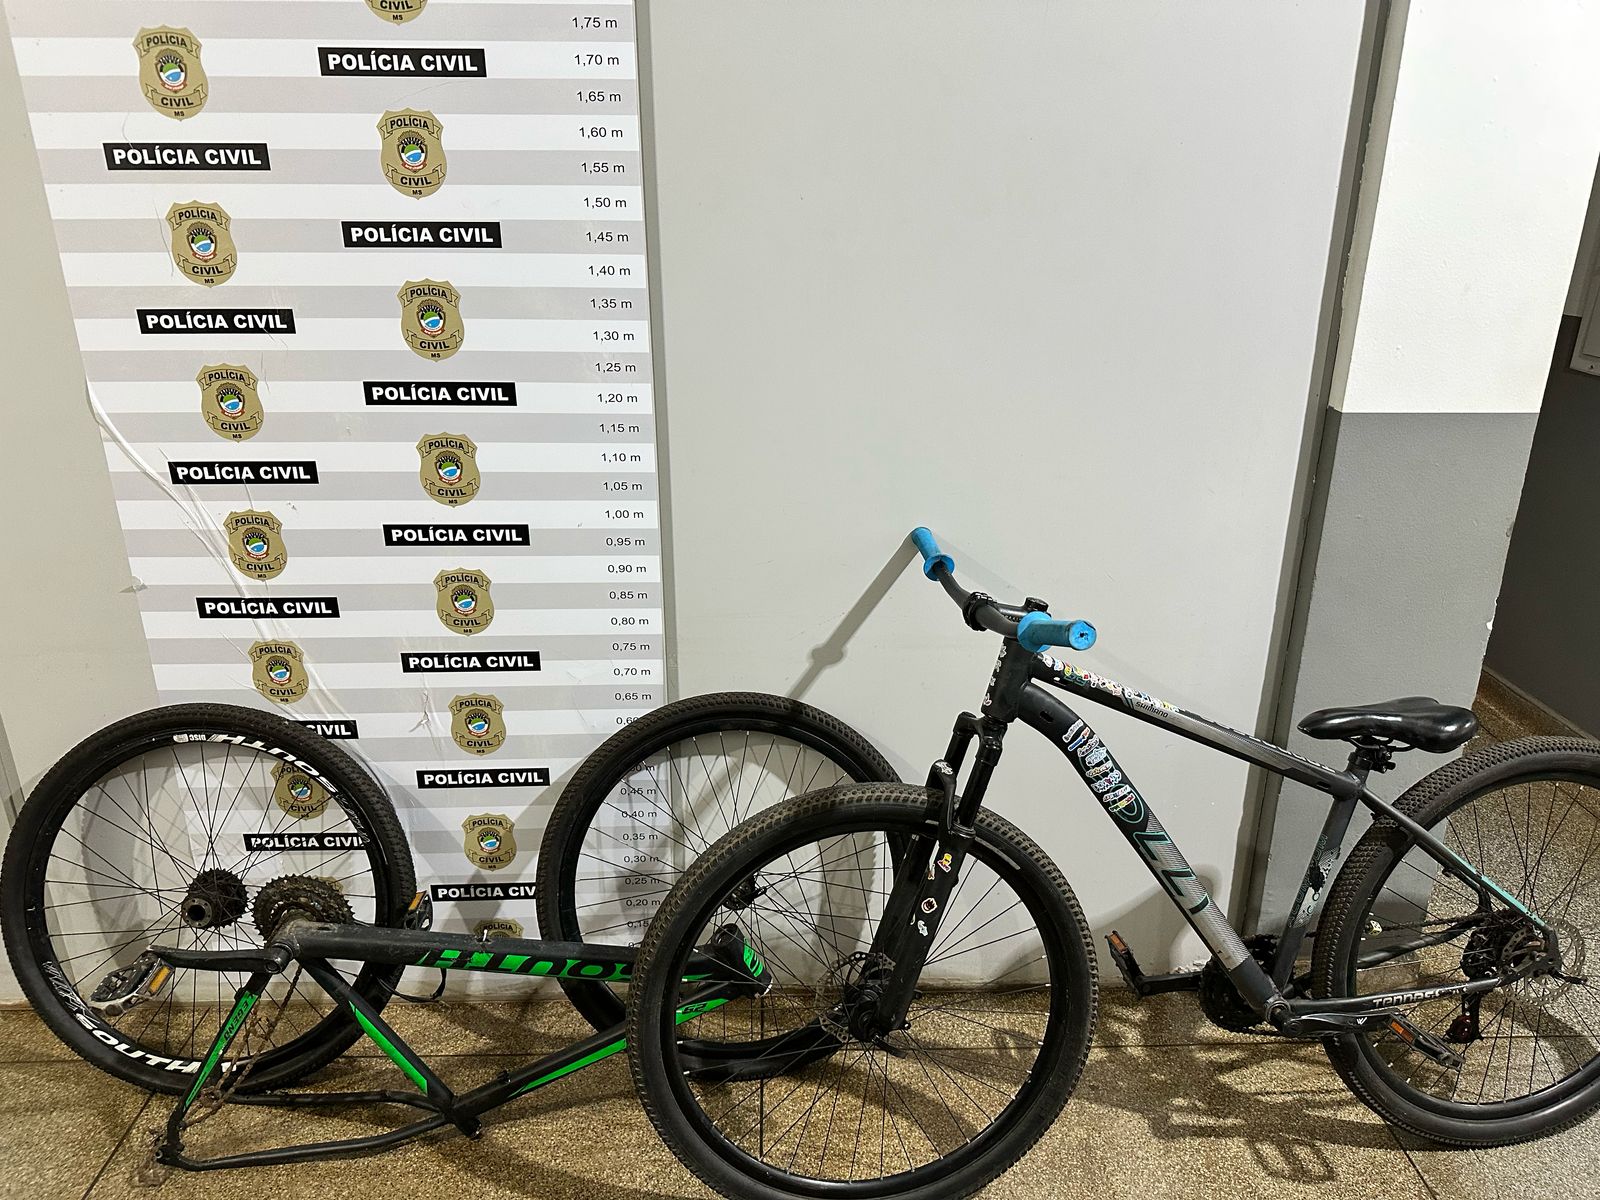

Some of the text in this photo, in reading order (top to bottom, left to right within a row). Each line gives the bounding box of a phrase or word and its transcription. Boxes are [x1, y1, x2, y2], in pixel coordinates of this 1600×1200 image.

[380, 0, 413, 10] CIVIL
[572, 17, 617, 29] 1,75 m
[146, 33, 187, 48] POLÍCIA
[328, 50, 477, 72] POLÍCIA CIVIL
[575, 54, 619, 66] 1,70 m
[161, 97, 194, 107] CIVIL
[577, 91, 621, 103] 1,65 m
[390, 116, 430, 130] POLÍCIA
[579, 127, 623, 139] 1,60 m
[113, 145, 262, 165] POLÍCIA CIVIL
[582, 162, 625, 174] 1,55 m
[400, 176, 432, 187] CIVIL
[584, 197, 610, 209] 1,50
[178, 208, 218, 221] POLÍCIA
[351, 224, 494, 243] POLÍCIA CIVIL
[586, 231, 629, 243] 1,45 m
[192, 265, 223, 275] CIVIL
[589, 265, 615, 277] 1,40
[410, 286, 447, 299] POLÍCIA
[591, 298, 617, 310] 1,35
[146, 311, 288, 329] POLÍCIA CIVIL
[593, 331, 619, 342] 1,30
[419, 340, 450, 350] CIVIL
[596, 363, 621, 374] 1,25
[208, 370, 245, 382] POLÍCIA
[372, 383, 509, 401] POLÍCIA CIVIL
[598, 394, 623, 404] 1,20
[220, 422, 250, 431] CIVIL
[600, 424, 625, 434] 1,15
[428, 438, 465, 450] POLÍCIA
[602, 453, 627, 463] 1,10
[177, 464, 311, 480] POLÍCIA CIVIL
[437, 488, 467, 496] CIVIL
[603, 482, 628, 492] 1,05
[234, 515, 270, 526] POLÍCIA
[605, 510, 630, 520] 1,00
[392, 526, 523, 542] POLÍCIA CIVIL
[606, 538, 631, 547] 0,95
[246, 563, 275, 571] CIVIL
[608, 564, 633, 574] 0,90
[444, 573, 480, 584] POLÍCIA
[610, 591, 634, 601] 0,85
[205, 599, 333, 615] POLÍCIA CIVIL
[453, 618, 481, 627] CIVIL
[611, 617, 636, 627] 0,80
[259, 645, 292, 655] POLÍCIA
[612, 643, 637, 652] 0,75
[409, 654, 534, 669] POLÍCIA CIVIL
[614, 668, 638, 677] 0,70
[615, 692, 639, 702] 0,65
[459, 699, 493, 708] POLÍCIA
[1135, 701, 1169, 719] SHIMANO
[217, 733, 339, 794] SOUTH
[424, 771, 544, 785] POLÍCIA CIVIL
[621, 788, 643, 796] 0,45
[622, 811, 644, 820] 0,40
[472, 818, 504, 827] POLÍCIA
[250, 834, 319, 848] POLÍCIA
[623, 833, 645, 842] 0,35
[624, 856, 646, 865] 0,30
[625, 878, 647, 887] 0,25
[437, 885, 537, 899] POLÍCIA CIV
[626, 899, 648, 908] 0,20
[483, 921, 514, 931] POLÍCIA
[75, 1011, 202, 1075] SOUTH
